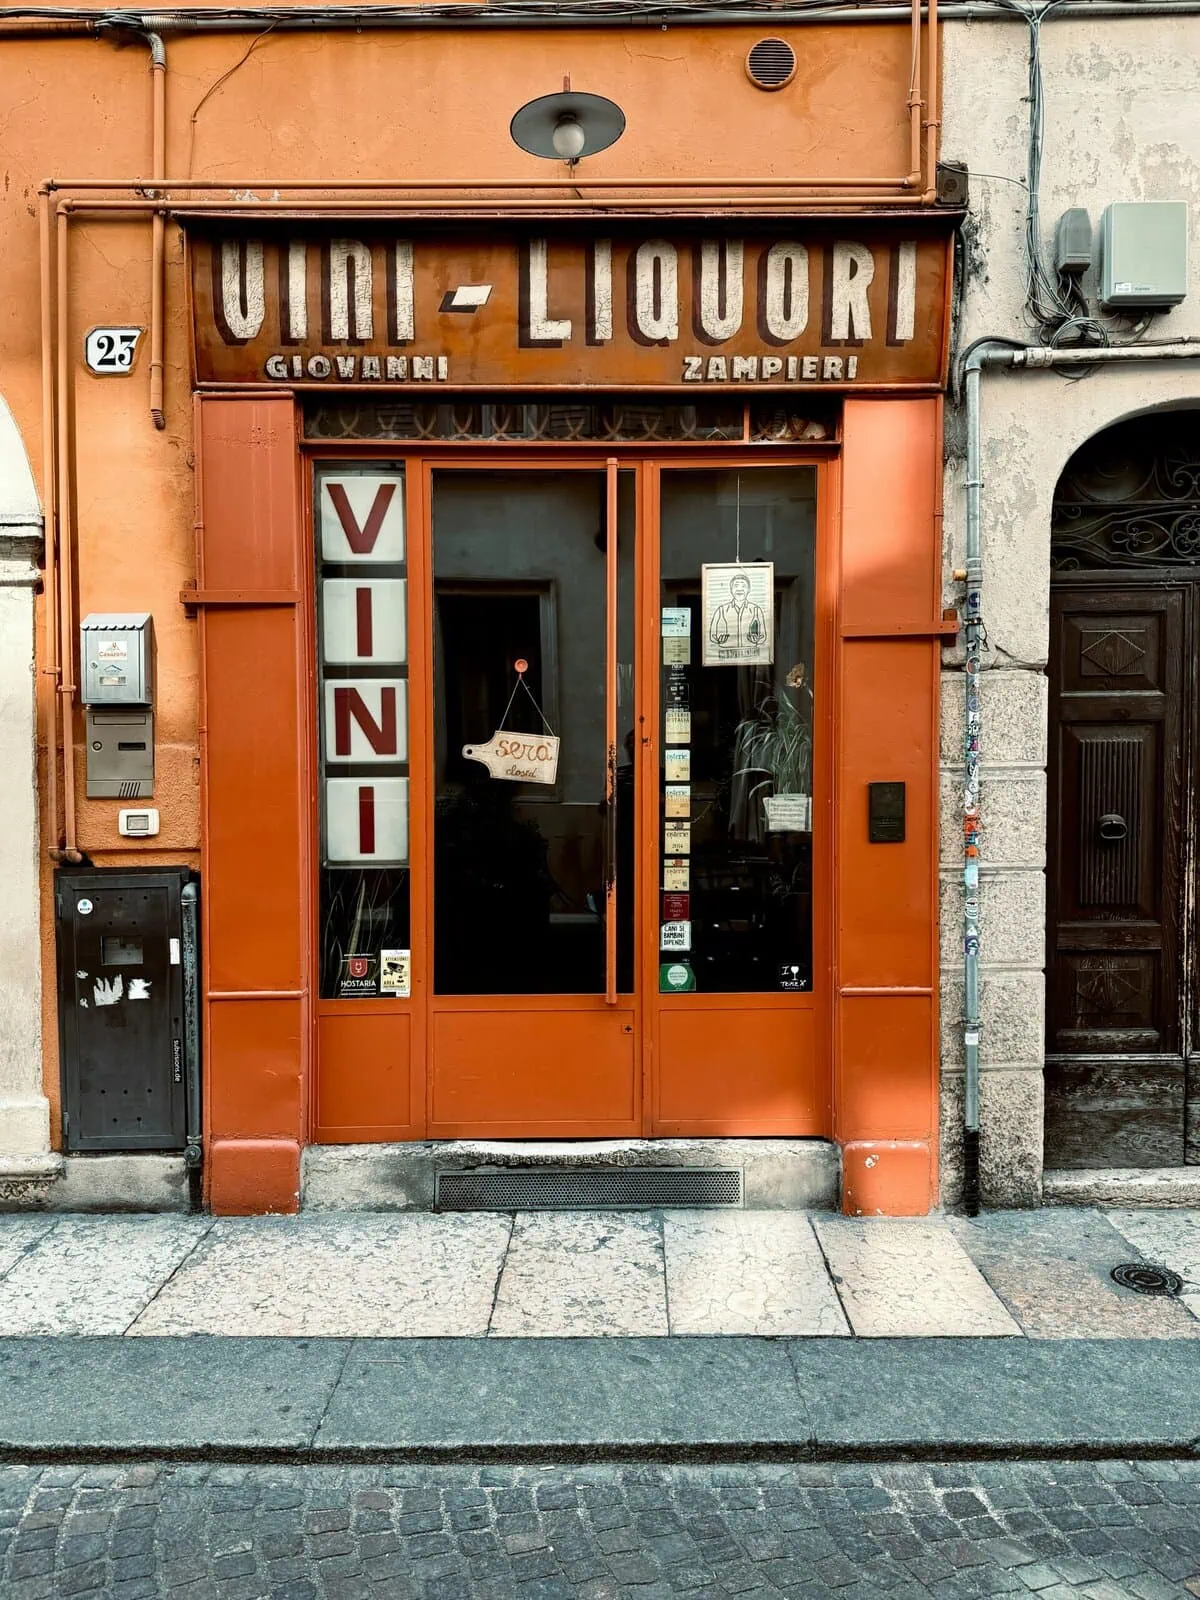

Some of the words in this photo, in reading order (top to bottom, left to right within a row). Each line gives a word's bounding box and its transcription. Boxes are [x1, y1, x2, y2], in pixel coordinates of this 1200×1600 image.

[529, 238, 917, 341] LIQUORI
[97, 335, 136, 366] 23
[265, 355, 449, 381] GIOVANNI
[683, 355, 858, 381] ZAMPIERI
[326, 484, 397, 854] VINI
